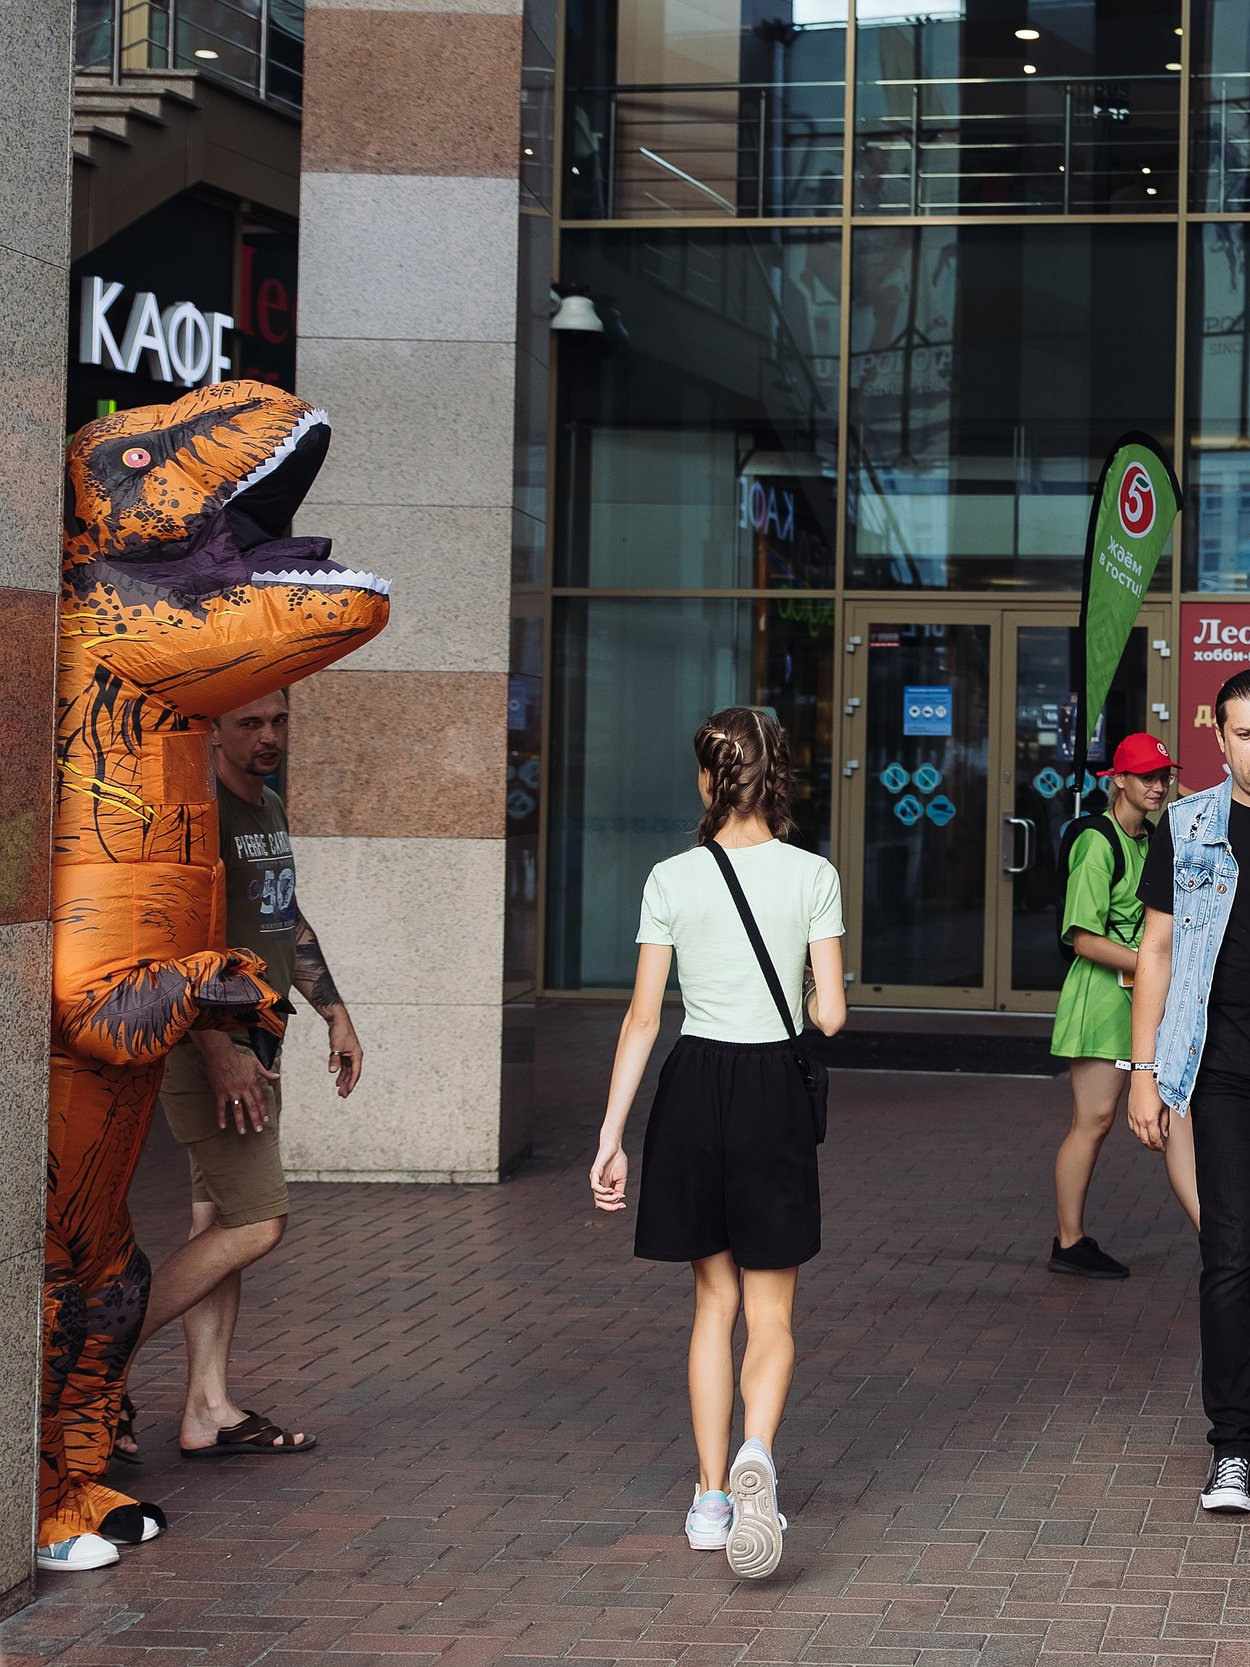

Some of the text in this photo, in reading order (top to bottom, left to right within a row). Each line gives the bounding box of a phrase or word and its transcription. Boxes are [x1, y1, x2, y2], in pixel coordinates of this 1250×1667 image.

[80, 275, 234, 388] КАФЕ
[1098, 551, 1143, 599] в гости!
[1107, 535, 1143, 577] ждём
[235, 834, 268, 858] PIERRE
